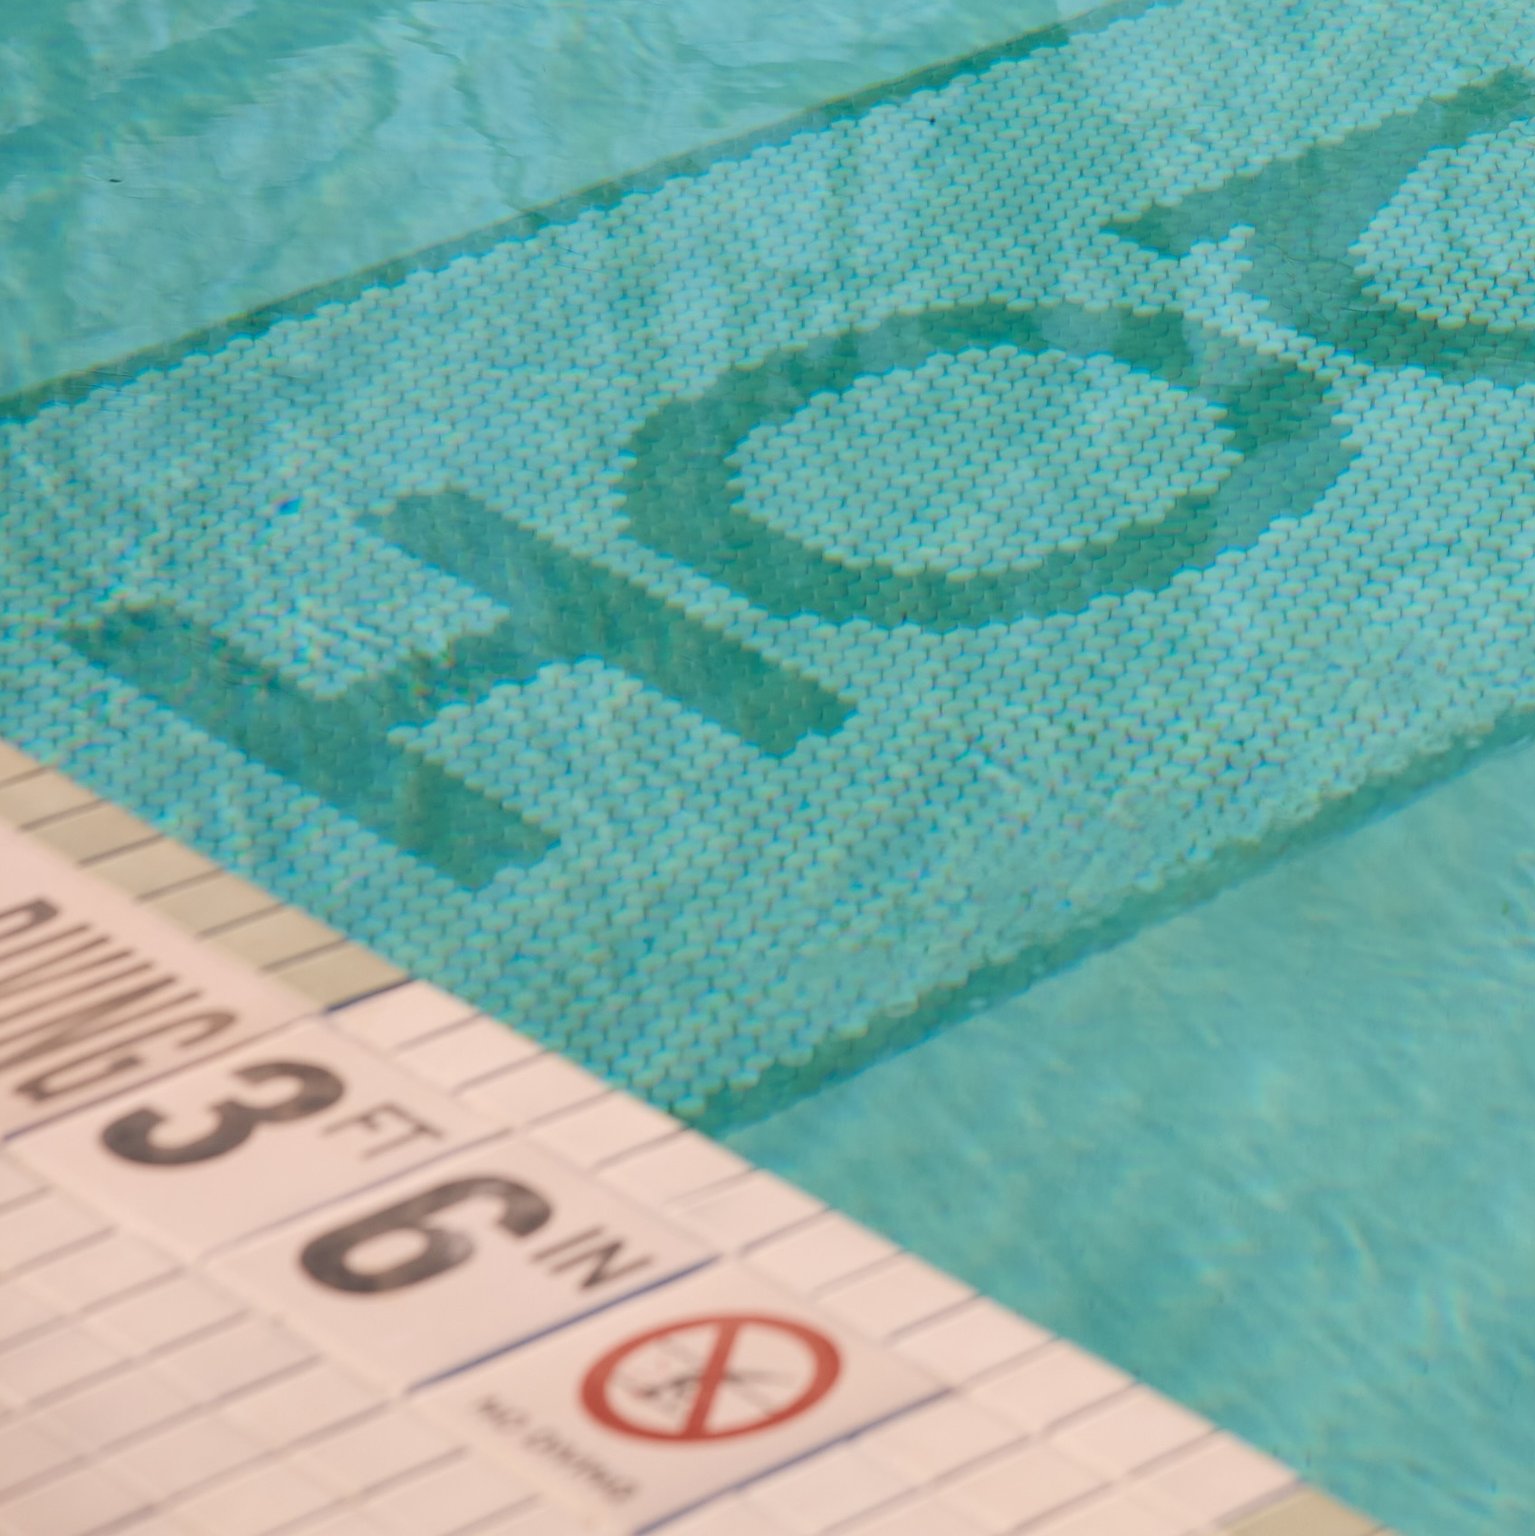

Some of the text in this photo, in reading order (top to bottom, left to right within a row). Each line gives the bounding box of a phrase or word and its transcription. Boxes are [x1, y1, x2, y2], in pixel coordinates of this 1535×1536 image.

[0, 898, 241, 1104] VING
[100, 1057, 655, 1296] 3 FT 6 IN
